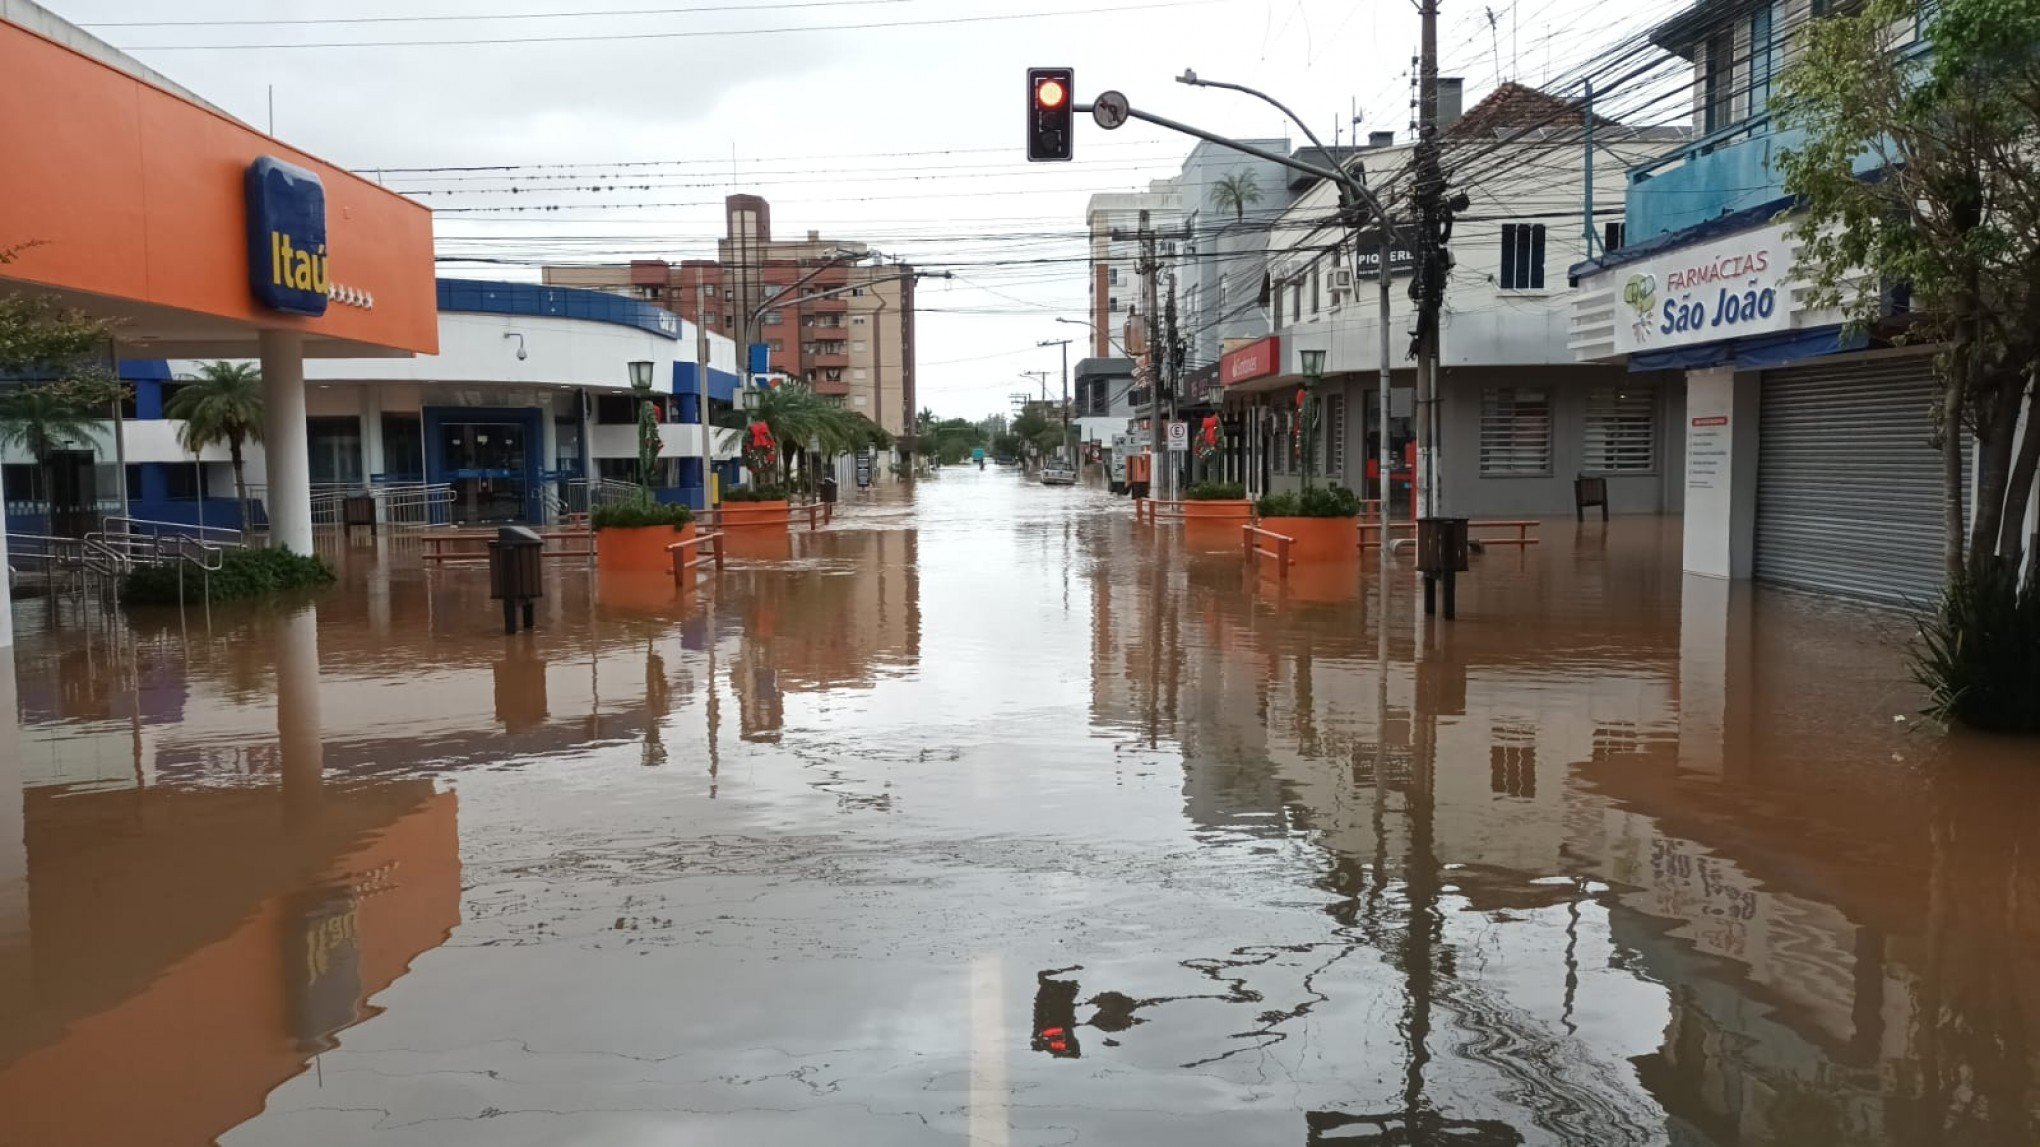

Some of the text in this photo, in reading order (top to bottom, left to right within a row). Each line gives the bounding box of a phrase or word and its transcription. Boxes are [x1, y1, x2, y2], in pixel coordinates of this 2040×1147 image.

[271, 231, 329, 294] Itaú
[1667, 249, 1769, 293] FARMÁCIAS
[1660, 278, 1775, 335] São João
